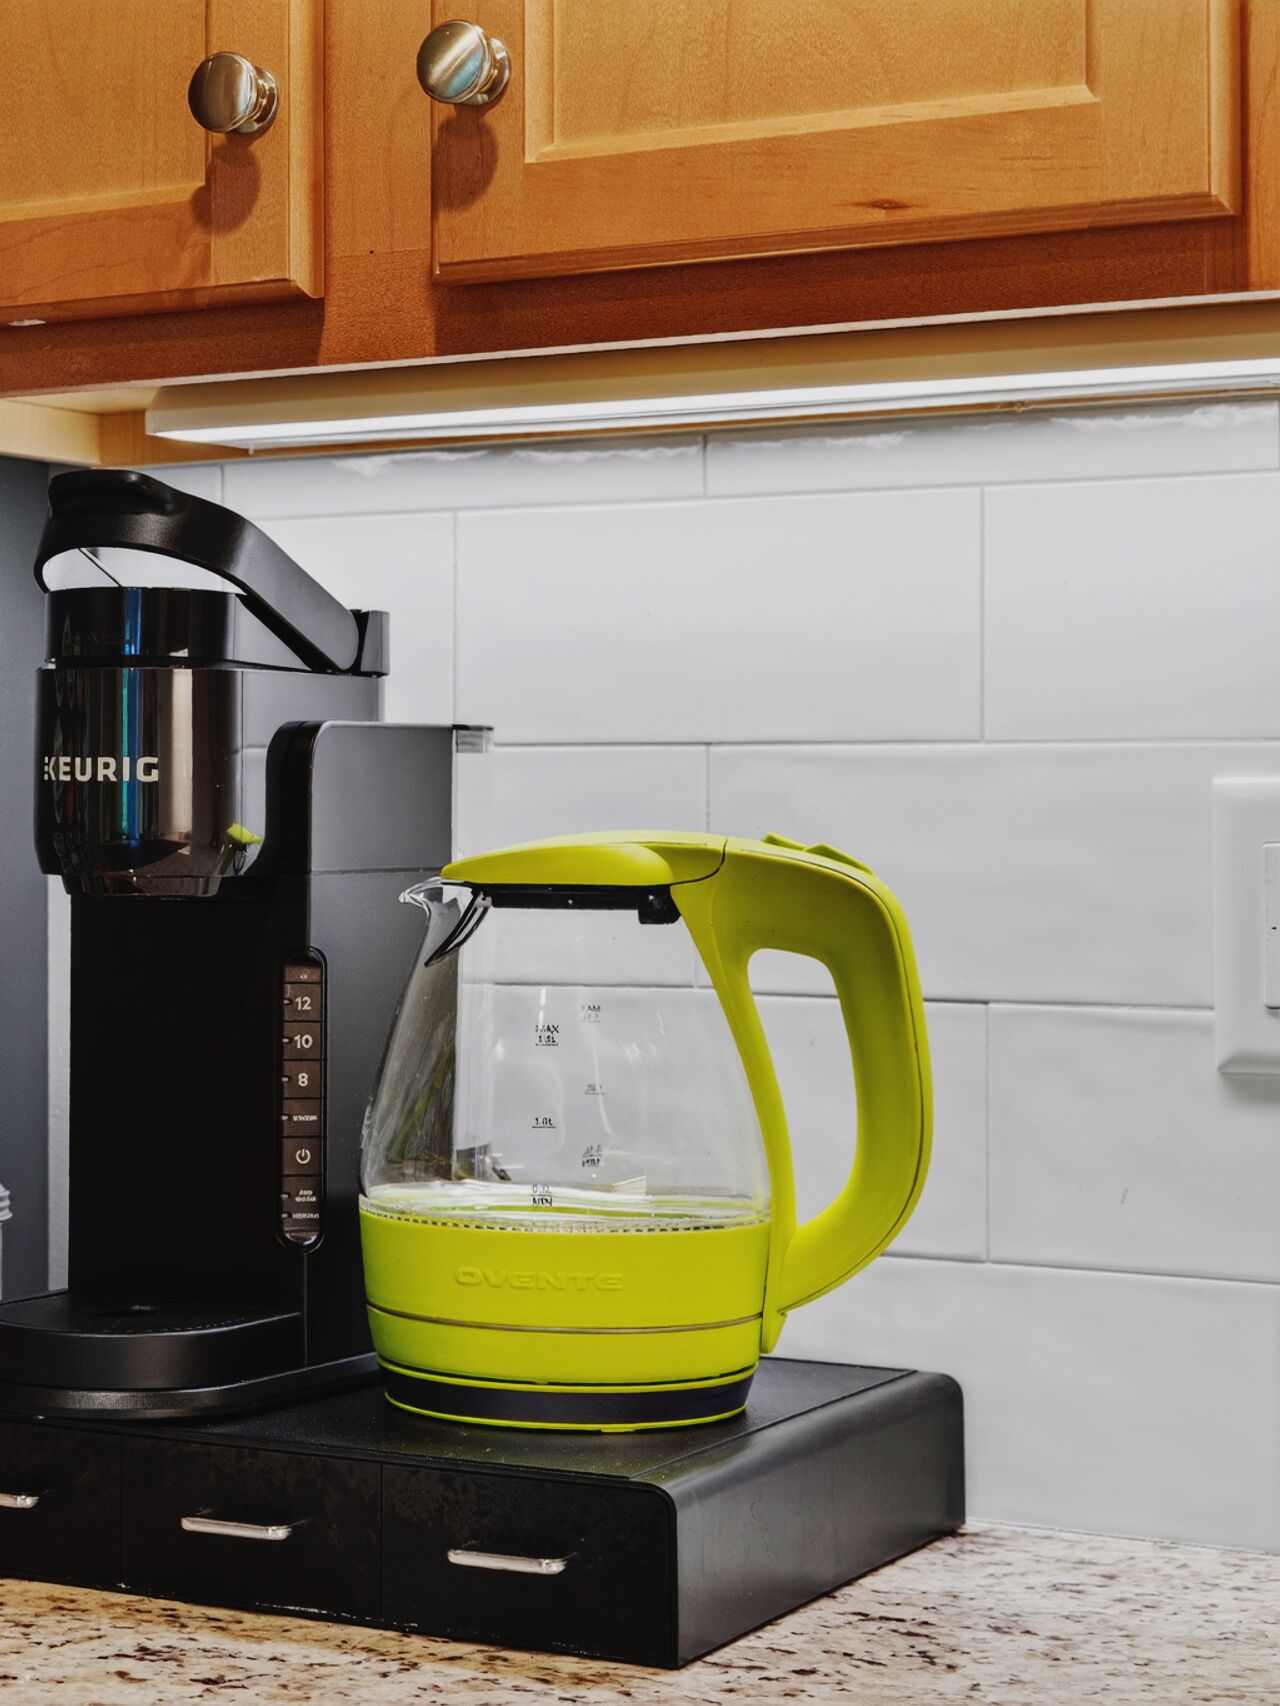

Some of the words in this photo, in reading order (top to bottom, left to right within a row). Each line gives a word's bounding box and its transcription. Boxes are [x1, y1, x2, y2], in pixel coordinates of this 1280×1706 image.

[44, 756, 159, 782] KEURIG
[295, 997, 312, 1011] 12
[294, 1034, 313, 1049] 10
[298, 1073, 309, 1087] 8
[454, 1266, 624, 1291] OVENTE
